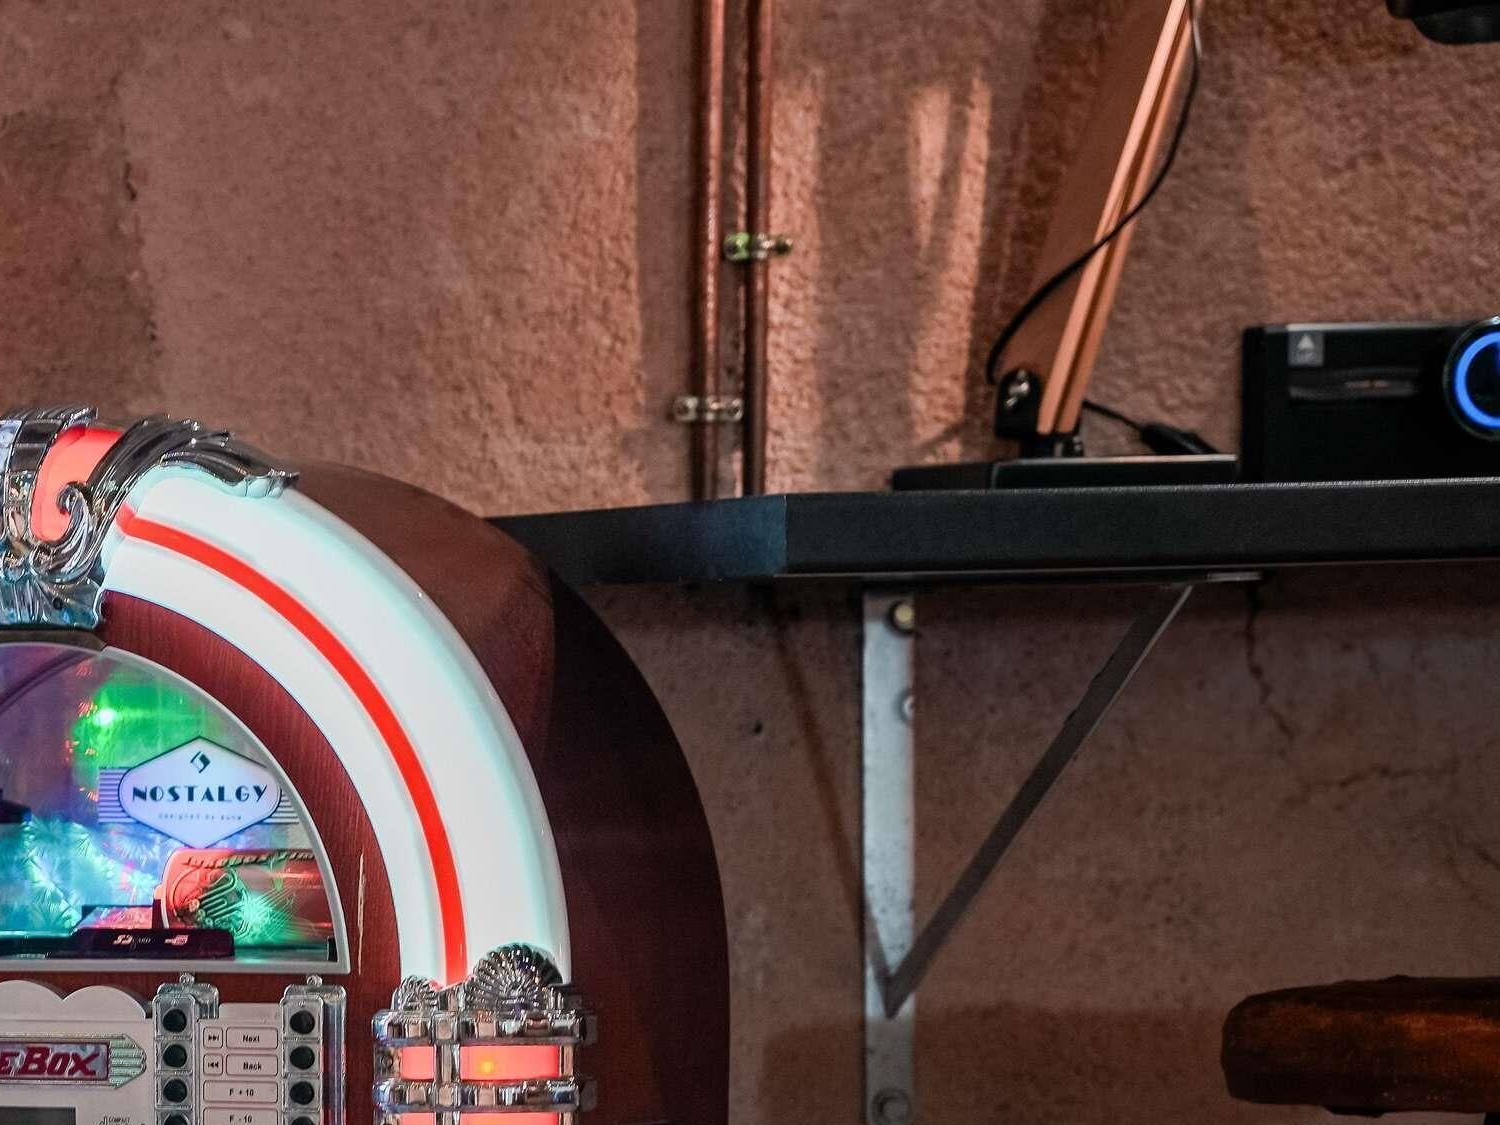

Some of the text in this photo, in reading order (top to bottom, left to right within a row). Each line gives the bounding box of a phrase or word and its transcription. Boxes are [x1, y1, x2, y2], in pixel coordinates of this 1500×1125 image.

[132, 784, 268, 802] NOSTALGY
[242, 1034, 260, 1043] Next
[243, 1062, 262, 1071] Back
